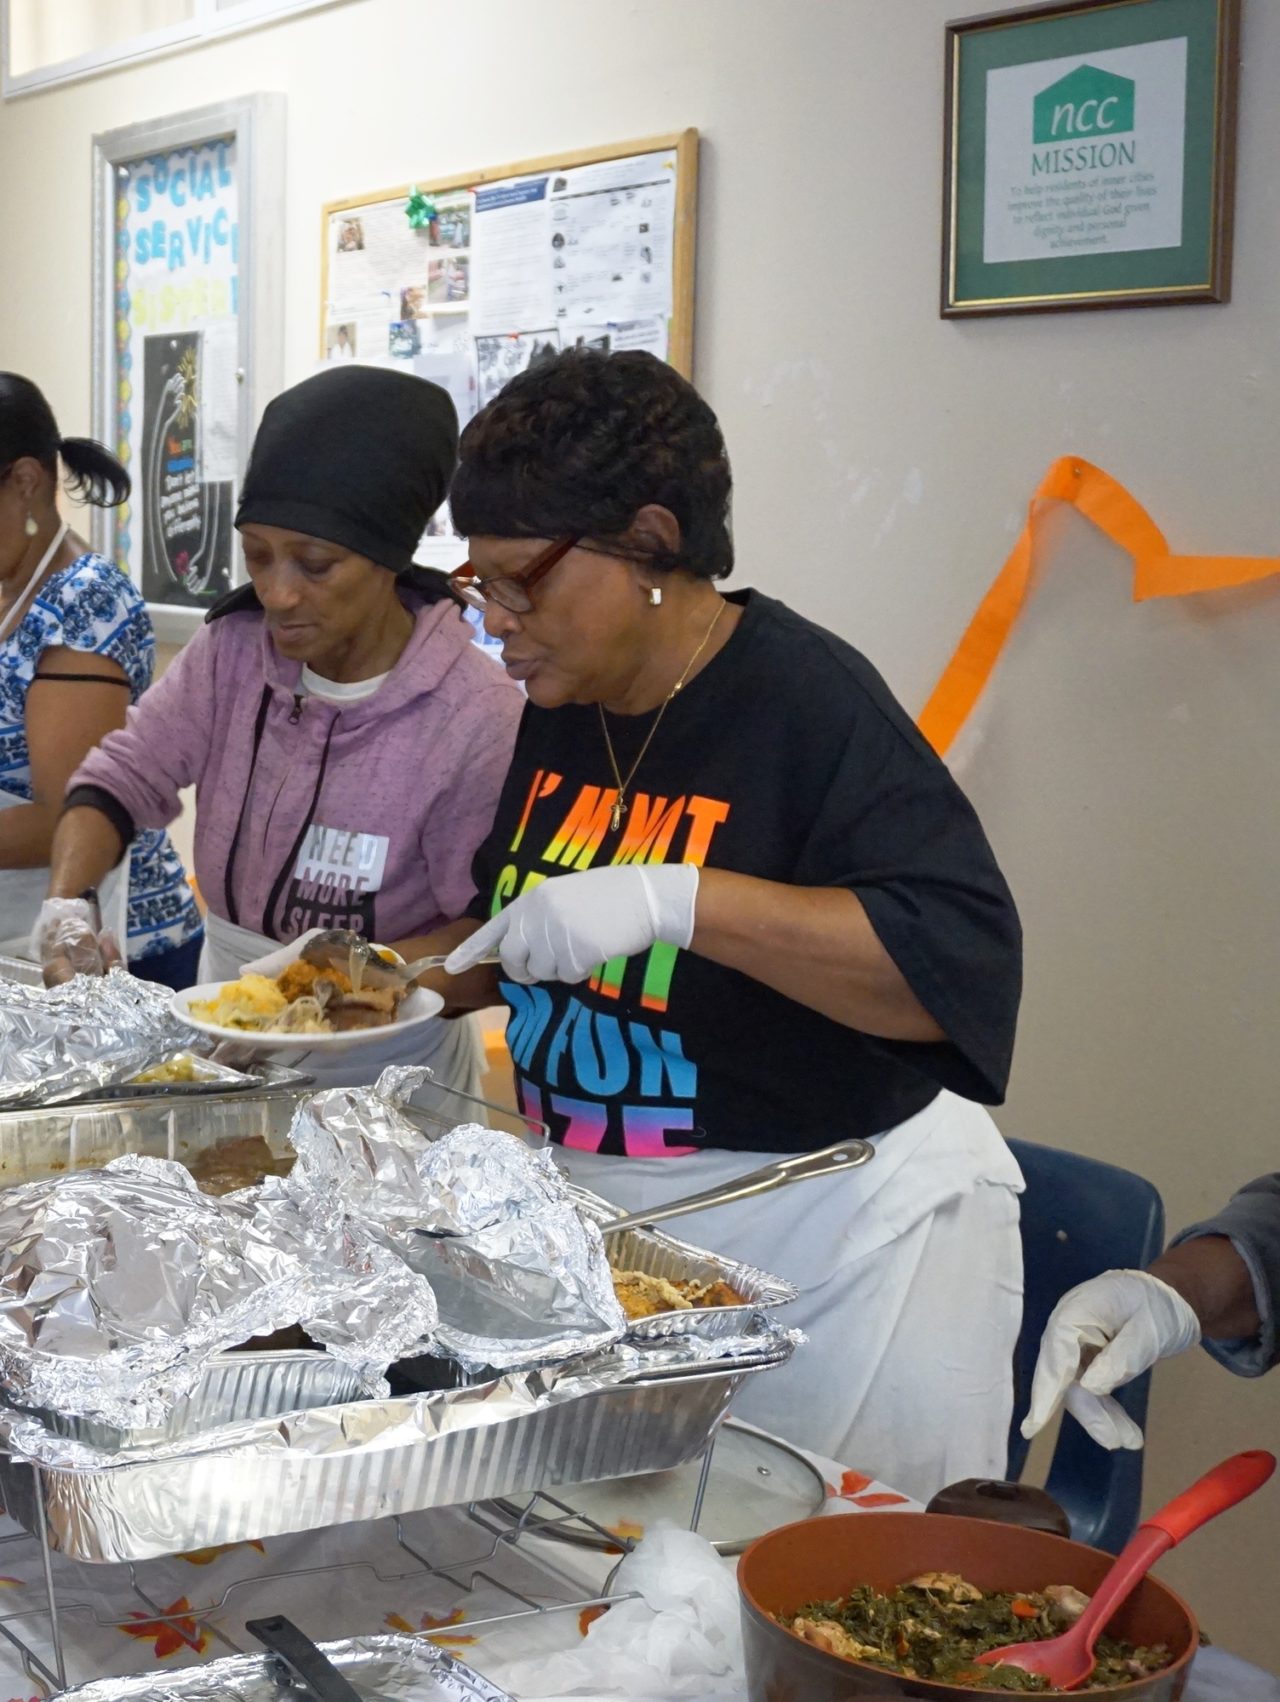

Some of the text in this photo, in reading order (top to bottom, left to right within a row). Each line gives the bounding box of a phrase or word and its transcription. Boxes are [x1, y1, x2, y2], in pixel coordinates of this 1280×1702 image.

[1051, 96, 1118, 136] ncc
[135, 143, 232, 212] SOCIAL
[1031, 141, 1136, 176] MISSION
[134, 207, 239, 272] SERVIC
[308, 824, 379, 871] NEED
[297, 867, 370, 907] MORE
